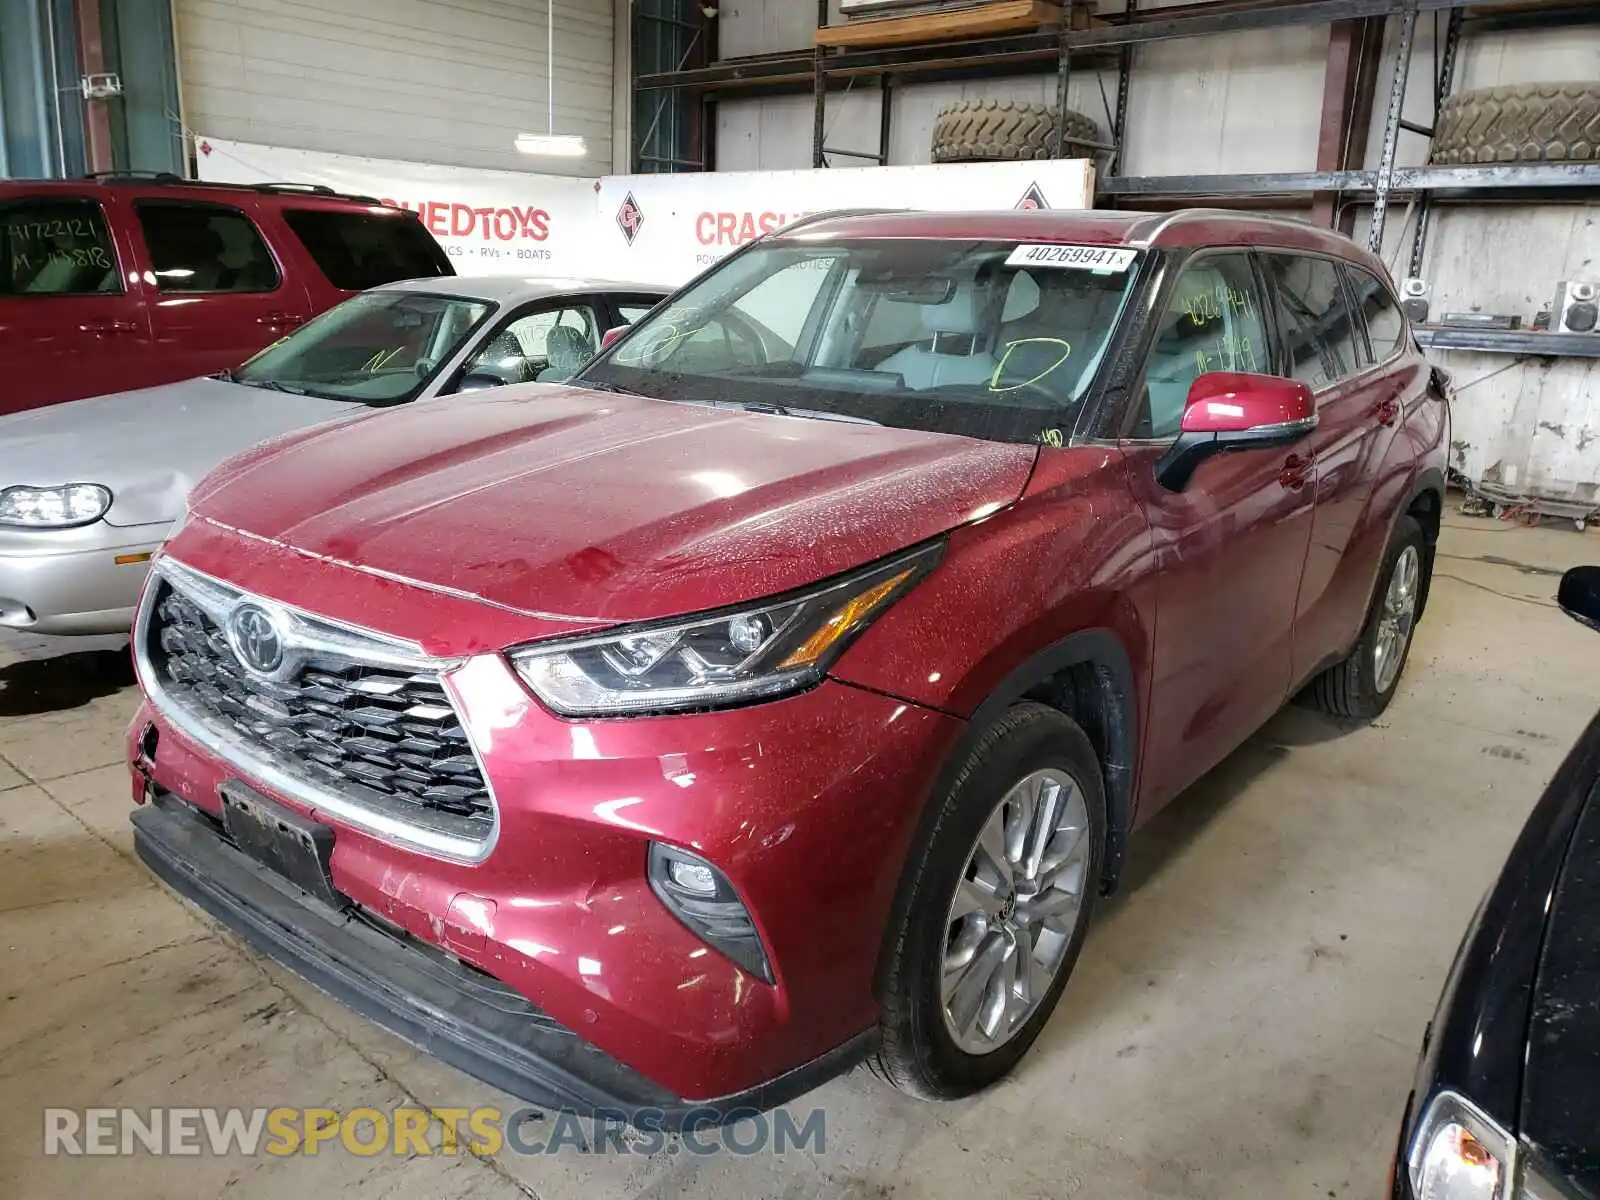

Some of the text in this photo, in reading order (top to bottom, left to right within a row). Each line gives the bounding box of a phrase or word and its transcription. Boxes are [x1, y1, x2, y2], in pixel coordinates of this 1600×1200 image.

[380, 198, 550, 241] EDTOYS
[441, 245, 551, 260] ICS RVs BOATS
[1026, 247, 1116, 264] 40269941
